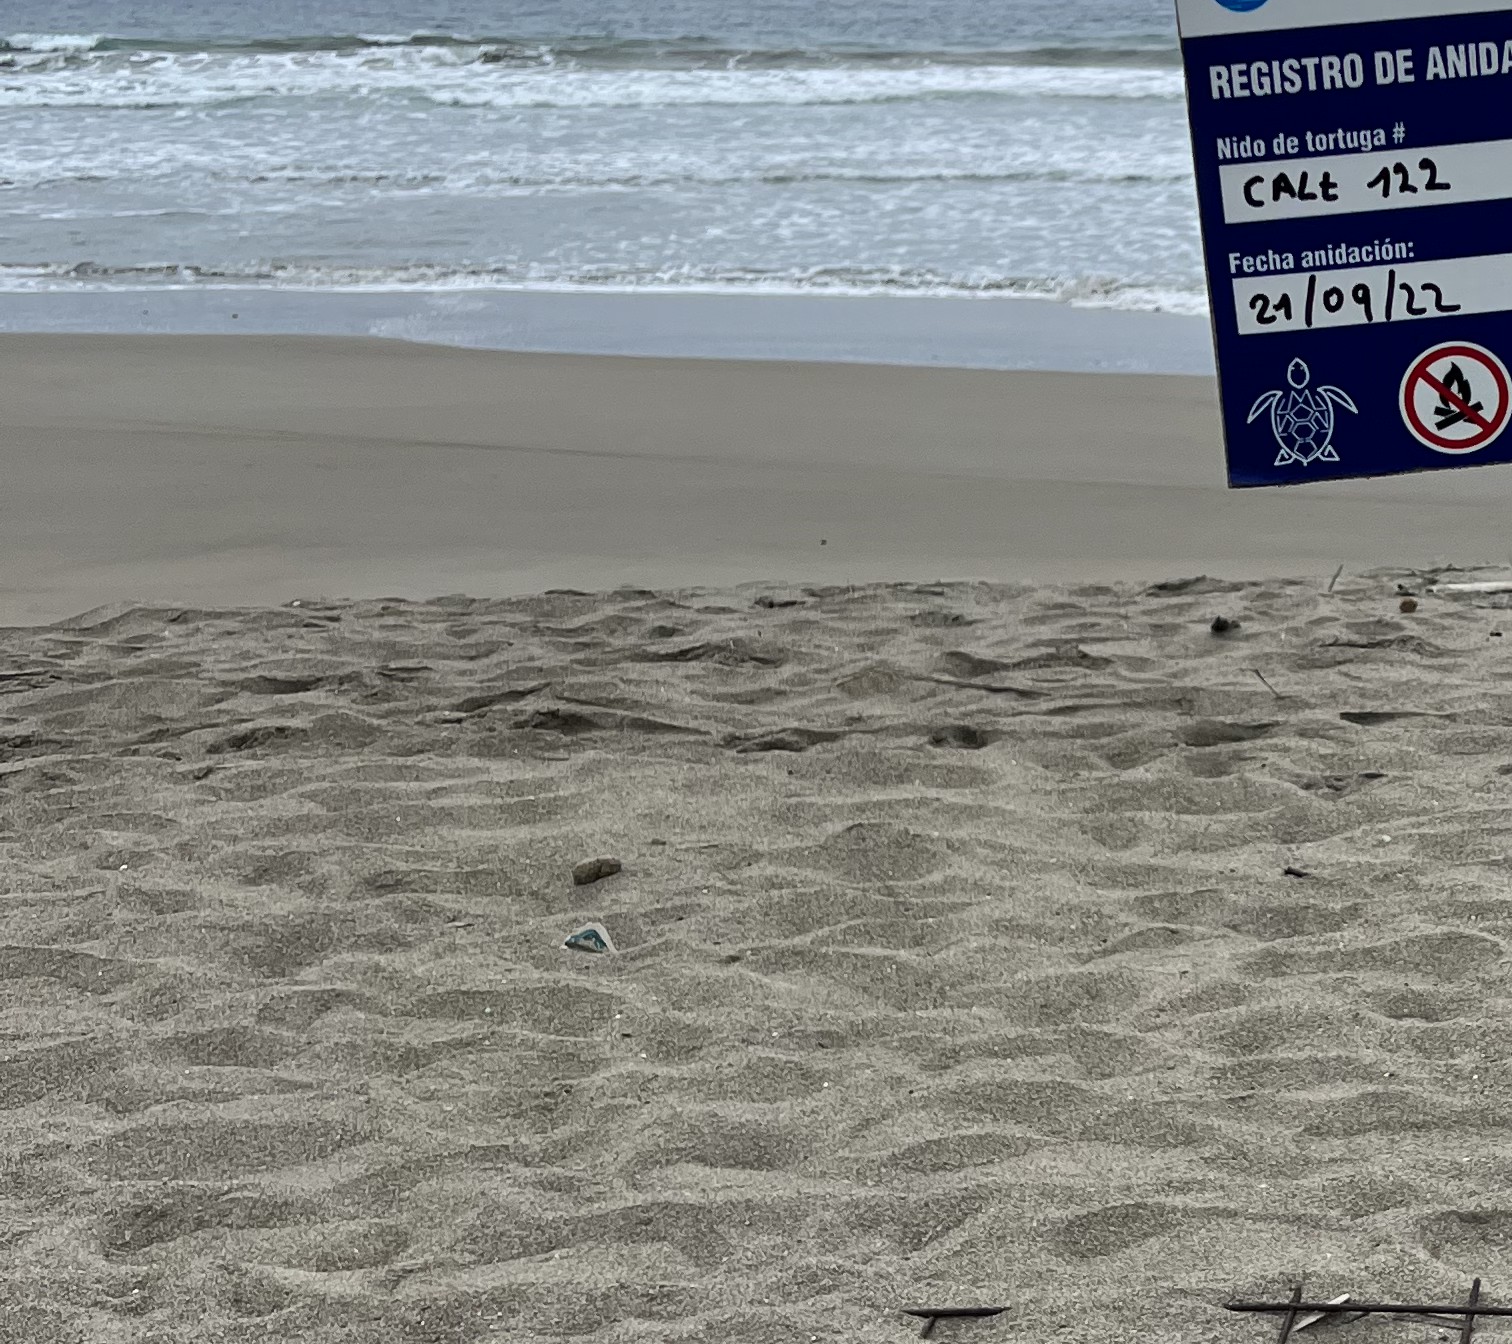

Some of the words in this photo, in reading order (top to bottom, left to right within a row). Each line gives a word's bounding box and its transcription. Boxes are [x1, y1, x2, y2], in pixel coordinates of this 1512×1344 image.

[1208, 52, 1364, 100] REGISTRO
[1373, 48, 1416, 86] DE
[1216, 135, 1266, 160] Nido
[1272, 132, 1299, 155] de
[1305, 127, 1386, 152] tortuga
[1392, 121, 1406, 144] #
[1366, 157, 1452, 199] 122
[1228, 249, 1295, 274] Fecha
[1301, 237, 1415, 269] anidación:
[1248, 268, 1462, 328] 21/09/22
